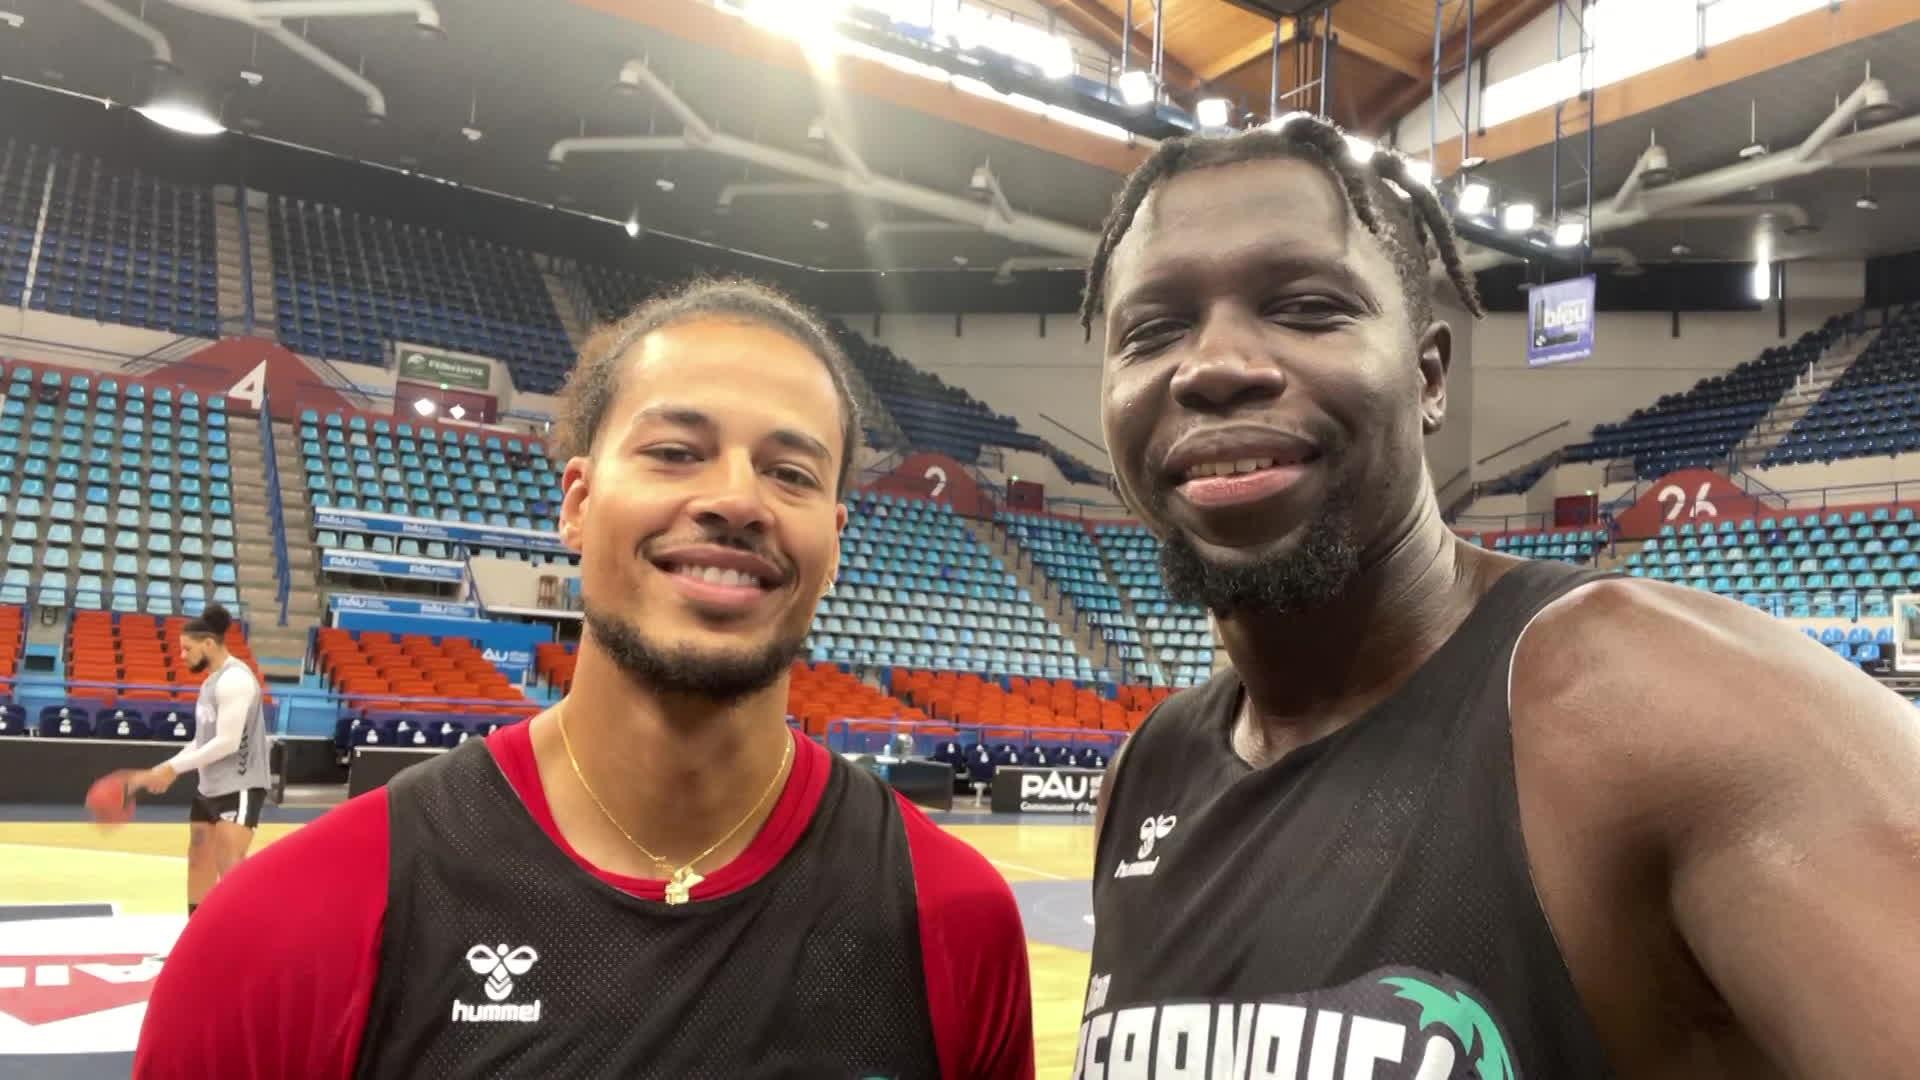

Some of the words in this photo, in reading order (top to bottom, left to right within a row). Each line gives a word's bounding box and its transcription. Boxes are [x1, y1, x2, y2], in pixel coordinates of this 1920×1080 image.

[228, 359, 267, 410] 4
[481, 647, 509, 662] AU
[1020, 769, 1089, 800] PAU
[451, 998, 542, 1023] hummel
